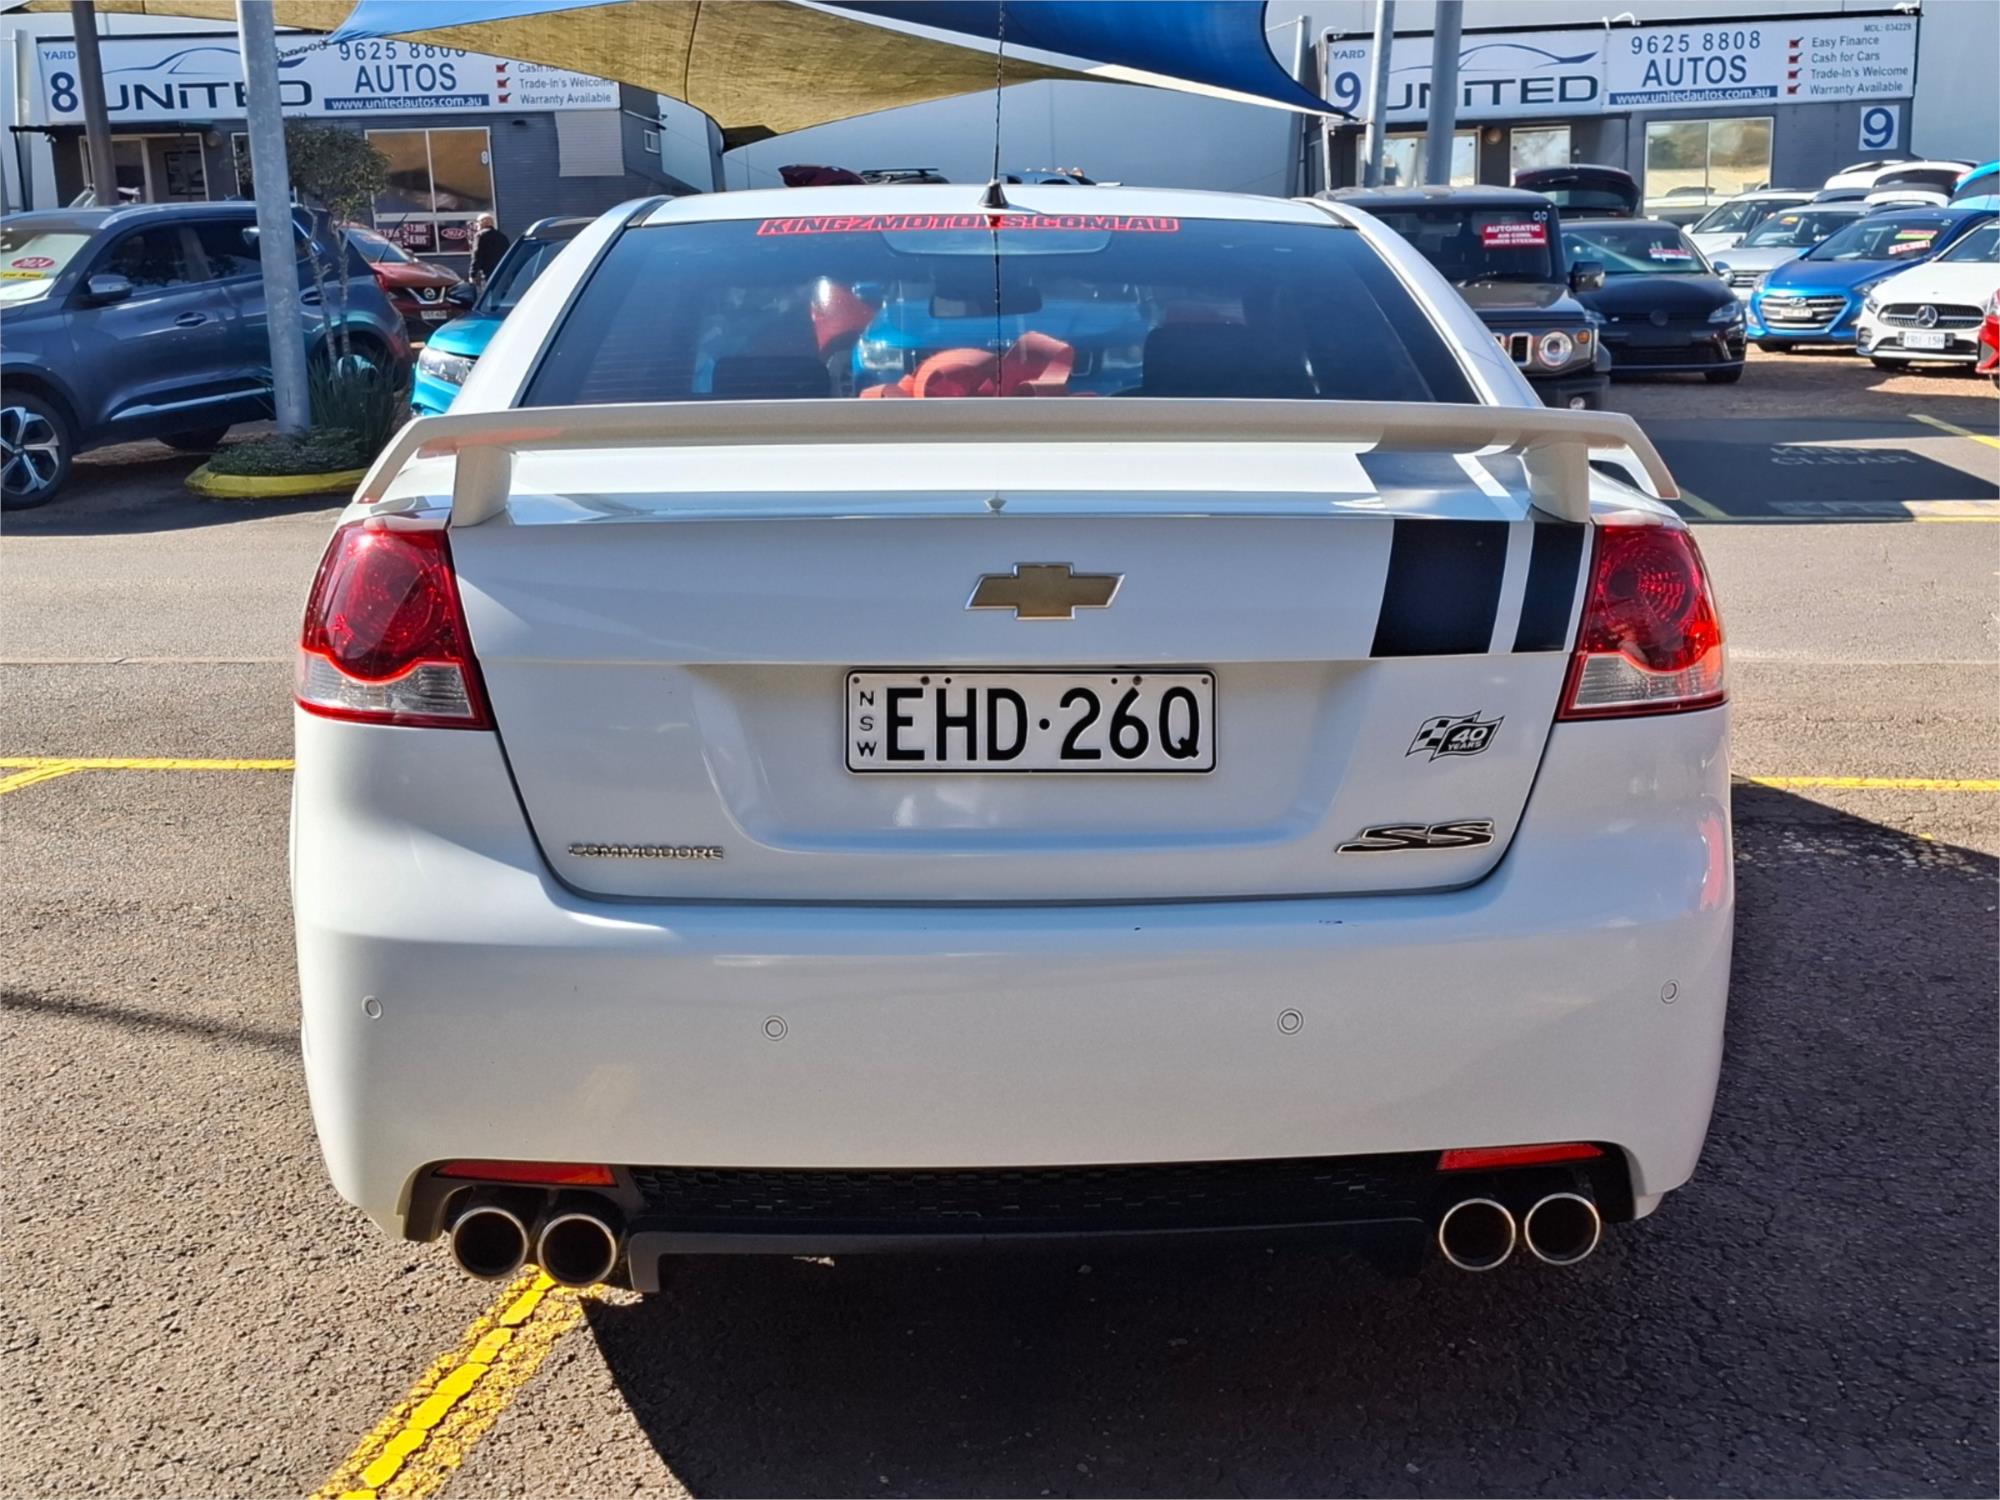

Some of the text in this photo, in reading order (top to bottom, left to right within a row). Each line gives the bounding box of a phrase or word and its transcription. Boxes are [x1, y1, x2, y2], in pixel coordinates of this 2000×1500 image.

[1631, 30, 1761, 55] 9625 8808
[1811, 35, 1880, 49] Easy Finance
[43, 50, 76, 60] YARD
[339, 42, 397, 61] 9625
[1332, 49, 1366, 60] YARD
[1811, 51, 1880, 64] Cash for Cars
[355, 62, 457, 93] AUTOS
[1641, 54, 1747, 88] AUTOS
[1862, 66, 1909, 78] Welcome
[50, 72, 78, 113] 8
[1334, 71, 1362, 113] 9
[1809, 81, 1903, 96] Warranty Available
[331, 95, 482, 110] www.unitedautos.com.au
[520, 93, 611, 106] Warranty Available
[1615, 90, 1771, 104] www.unitedautos.com.au
[1862, 106, 1895, 149] 9
[481, 151, 488, 164] 8
[1486, 225, 1541, 233] AUTOMATIC
[1452, 727, 1488, 742] 40
[1448, 741, 1482, 751] YEARS
[1335, 820, 1495, 854] SS
[568, 842, 725, 861] COMMODORE
